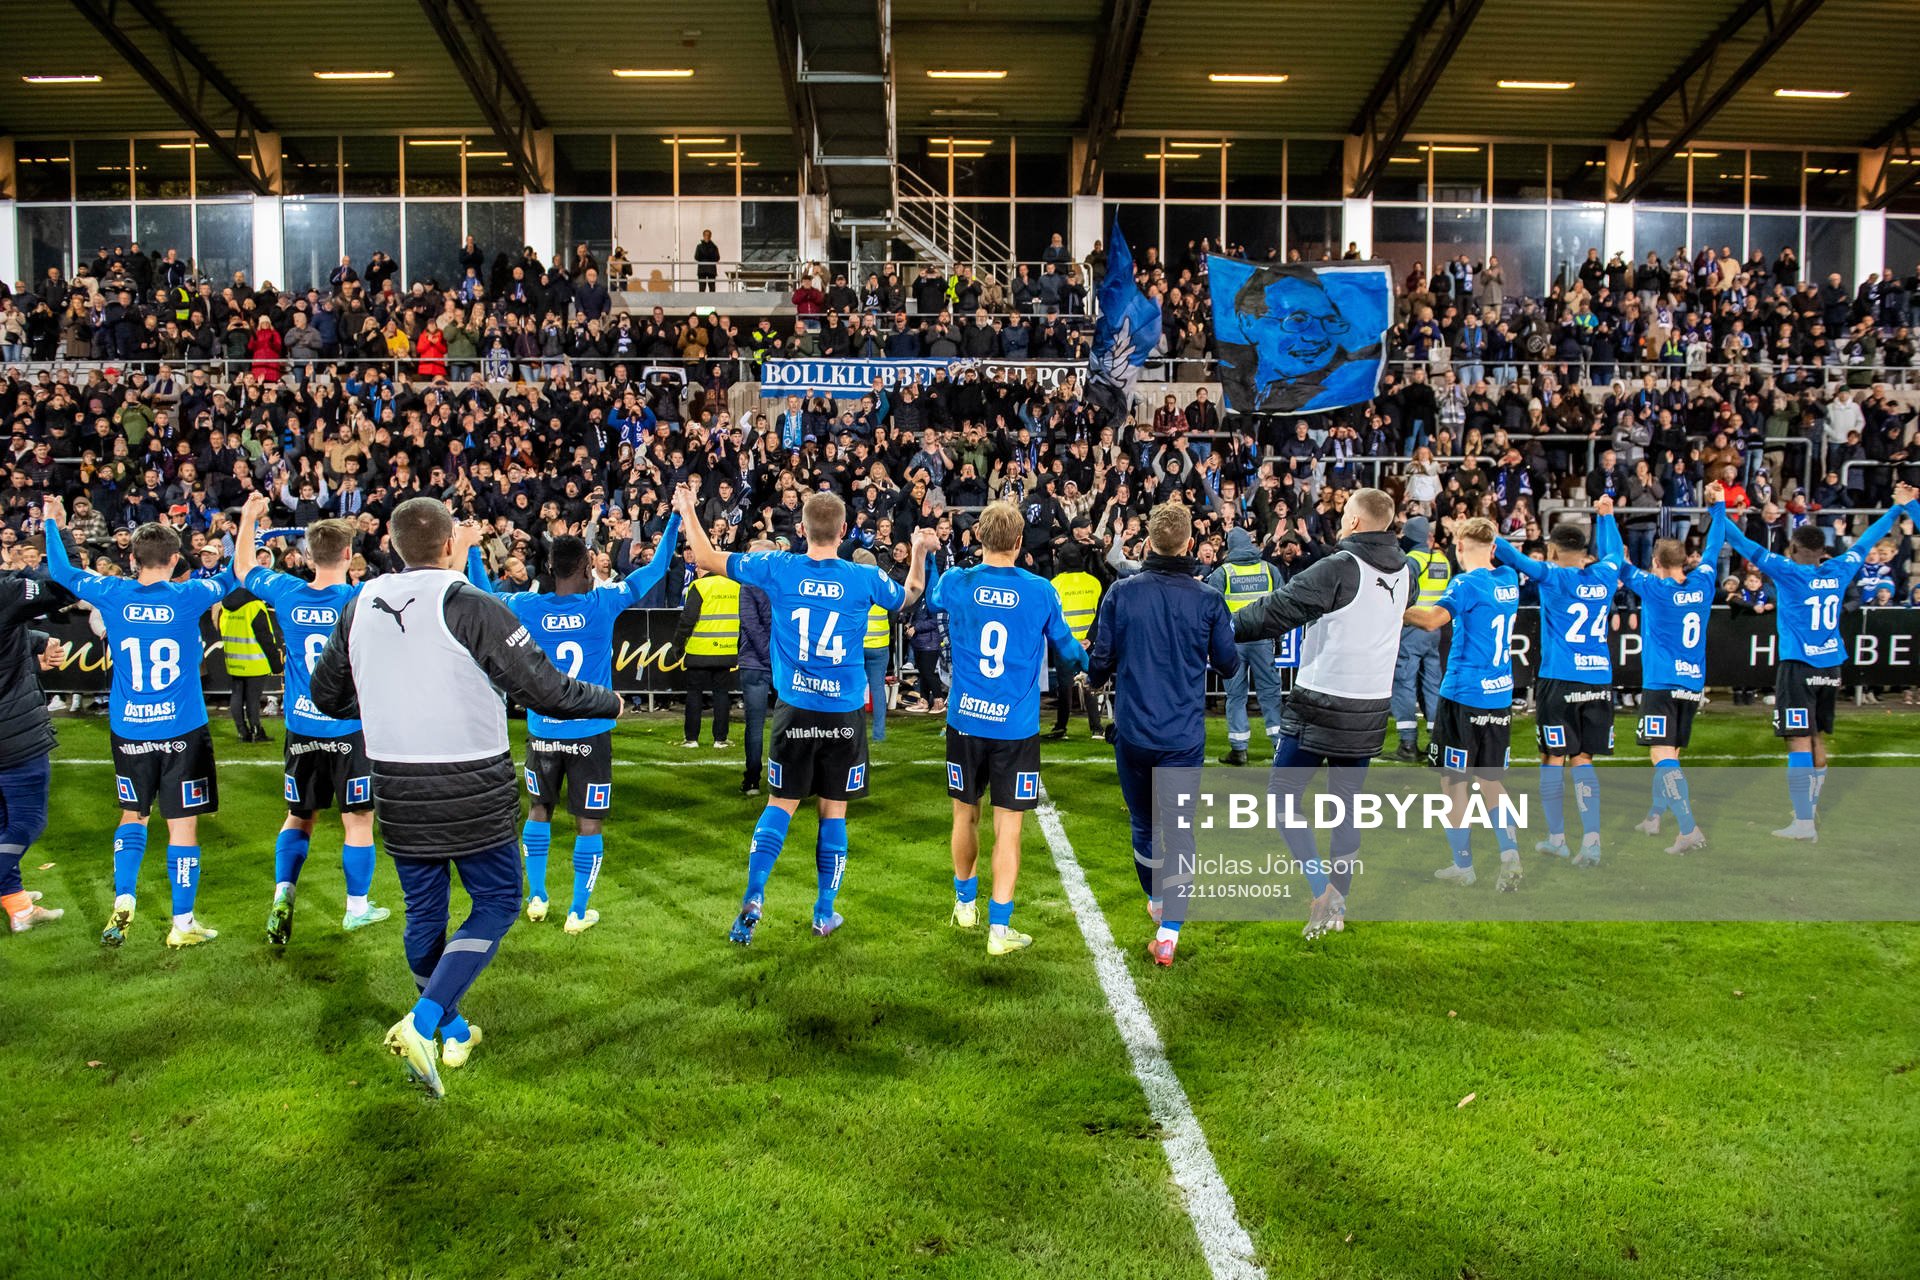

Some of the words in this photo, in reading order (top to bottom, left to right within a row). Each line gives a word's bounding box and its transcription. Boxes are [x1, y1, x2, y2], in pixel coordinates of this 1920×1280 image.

[1231, 575, 1267, 584] ORDNINGS
[1241, 583, 1259, 591] VAKT
[1811, 578, 1836, 589] EAB
[803, 581, 840, 598] EAB
[978, 588, 1016, 606] EAB
[1496, 587, 1518, 601] EAB
[1579, 586, 1605, 598] EAB
[1676, 592, 1701, 604] EAB
[128, 606, 170, 621] EAB
[297, 609, 335, 624] EAB
[1804, 594, 1839, 631] 10
[546, 615, 582, 630] EAB
[1565, 602, 1608, 643] 24
[791, 607, 847, 665] 14
[979, 620, 1008, 679] 9
[121, 637, 180, 692] 18
[556, 641, 584, 680] 2
[792, 669, 835, 692] ÖSTRAS
[124, 700, 171, 718] ÖSTRAS
[960, 692, 1005, 716] ÖSTRAS
[785, 726, 841, 739] villalivet
[532, 740, 579, 755] villalivet
